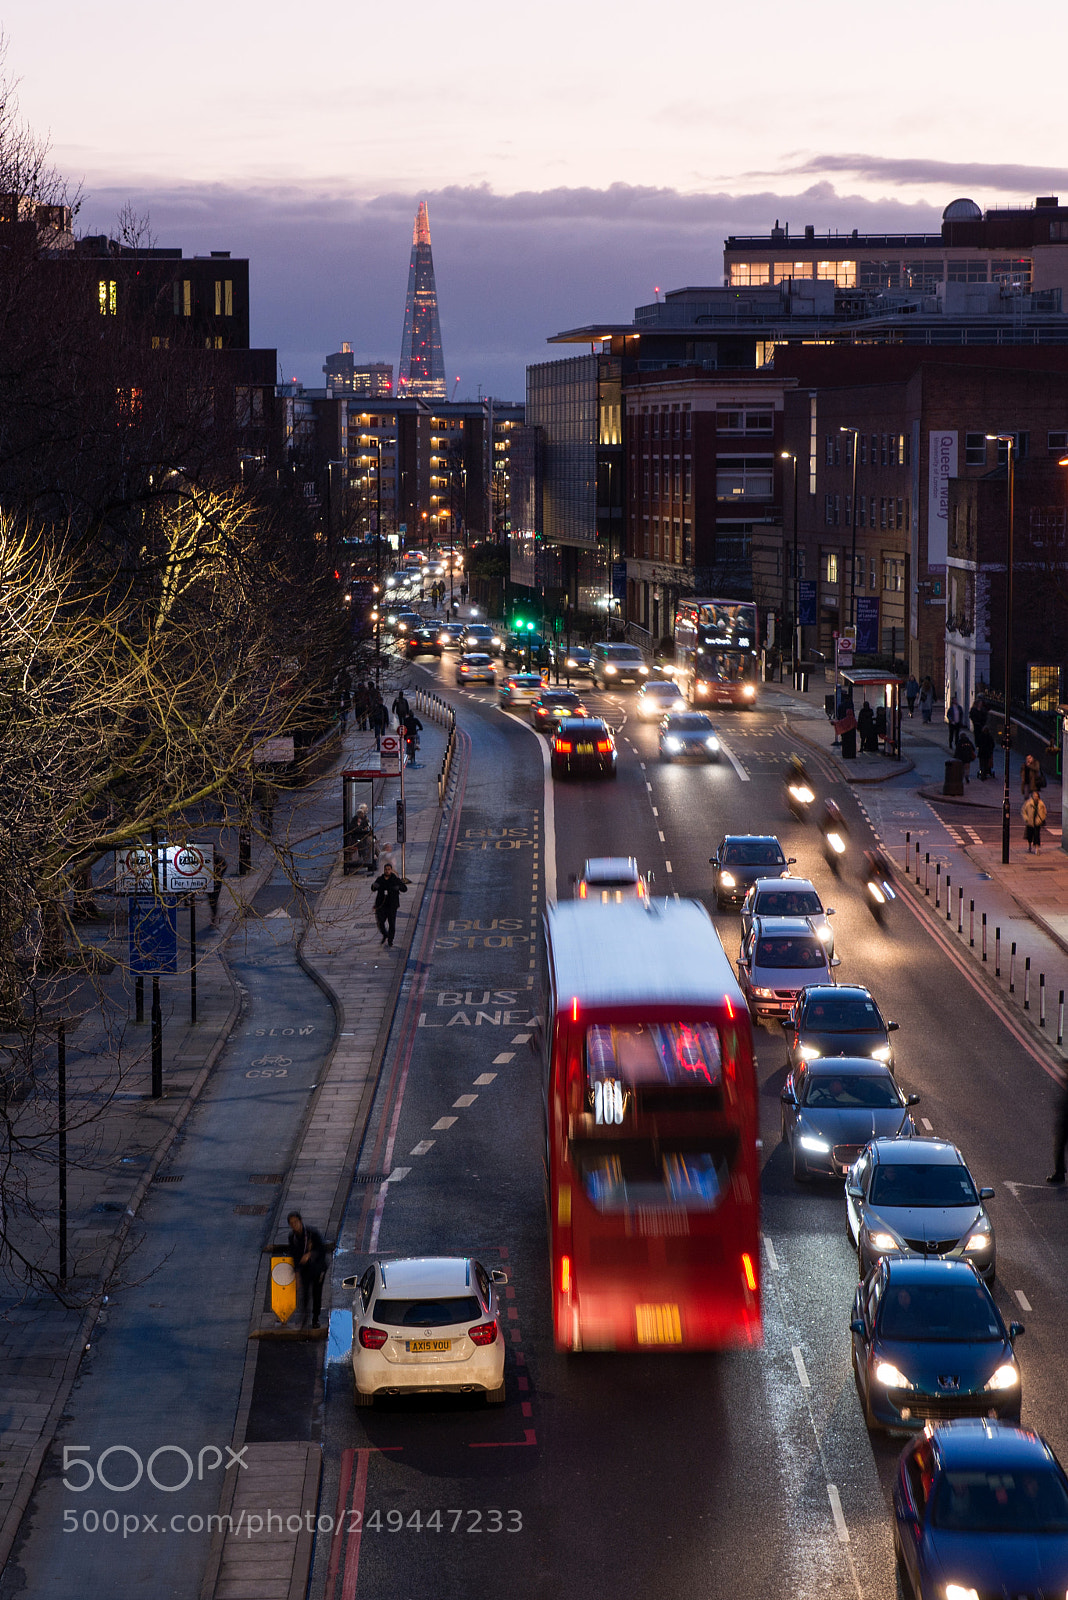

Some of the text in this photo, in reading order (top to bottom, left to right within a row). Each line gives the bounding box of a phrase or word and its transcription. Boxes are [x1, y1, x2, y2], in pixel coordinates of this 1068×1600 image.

[940, 436, 953, 481] Queen
[465, 828, 529, 838] BUS
[455, 840, 534, 850] STOP
[447, 919, 525, 932] BUS
[435, 936, 530, 949] STOP
[436, 991, 519, 1007] BUS
[418, 1010, 530, 1027] LANE
[255, 1027, 316, 1037] SLOW
[245, 1069, 288, 1079] CS2
[433, 1341, 449, 1350] VOU
